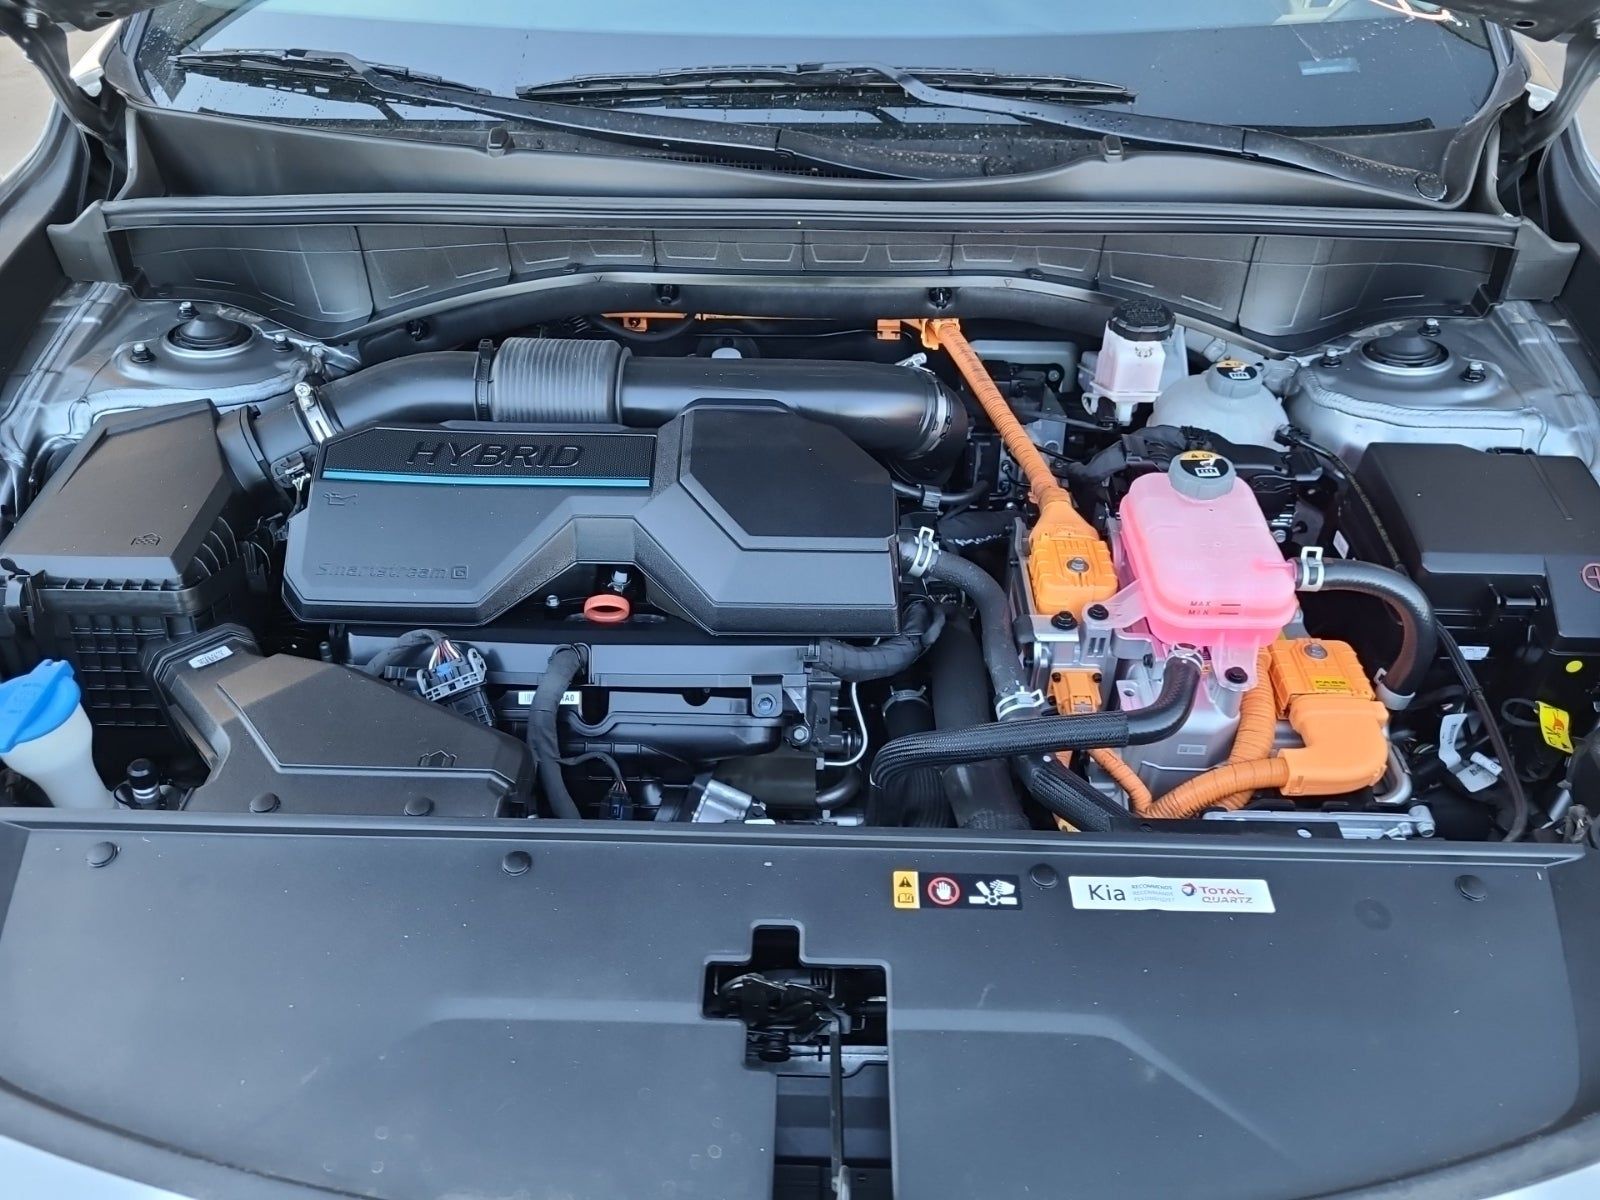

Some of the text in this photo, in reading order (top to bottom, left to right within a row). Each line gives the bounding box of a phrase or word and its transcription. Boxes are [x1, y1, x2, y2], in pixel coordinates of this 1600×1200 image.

[406, 441, 585, 468] HYBRID
[1088, 884, 1126, 901] Kia
[1199, 886, 1245, 895] TOTAL
[1202, 896, 1253, 904] QUARTZ
